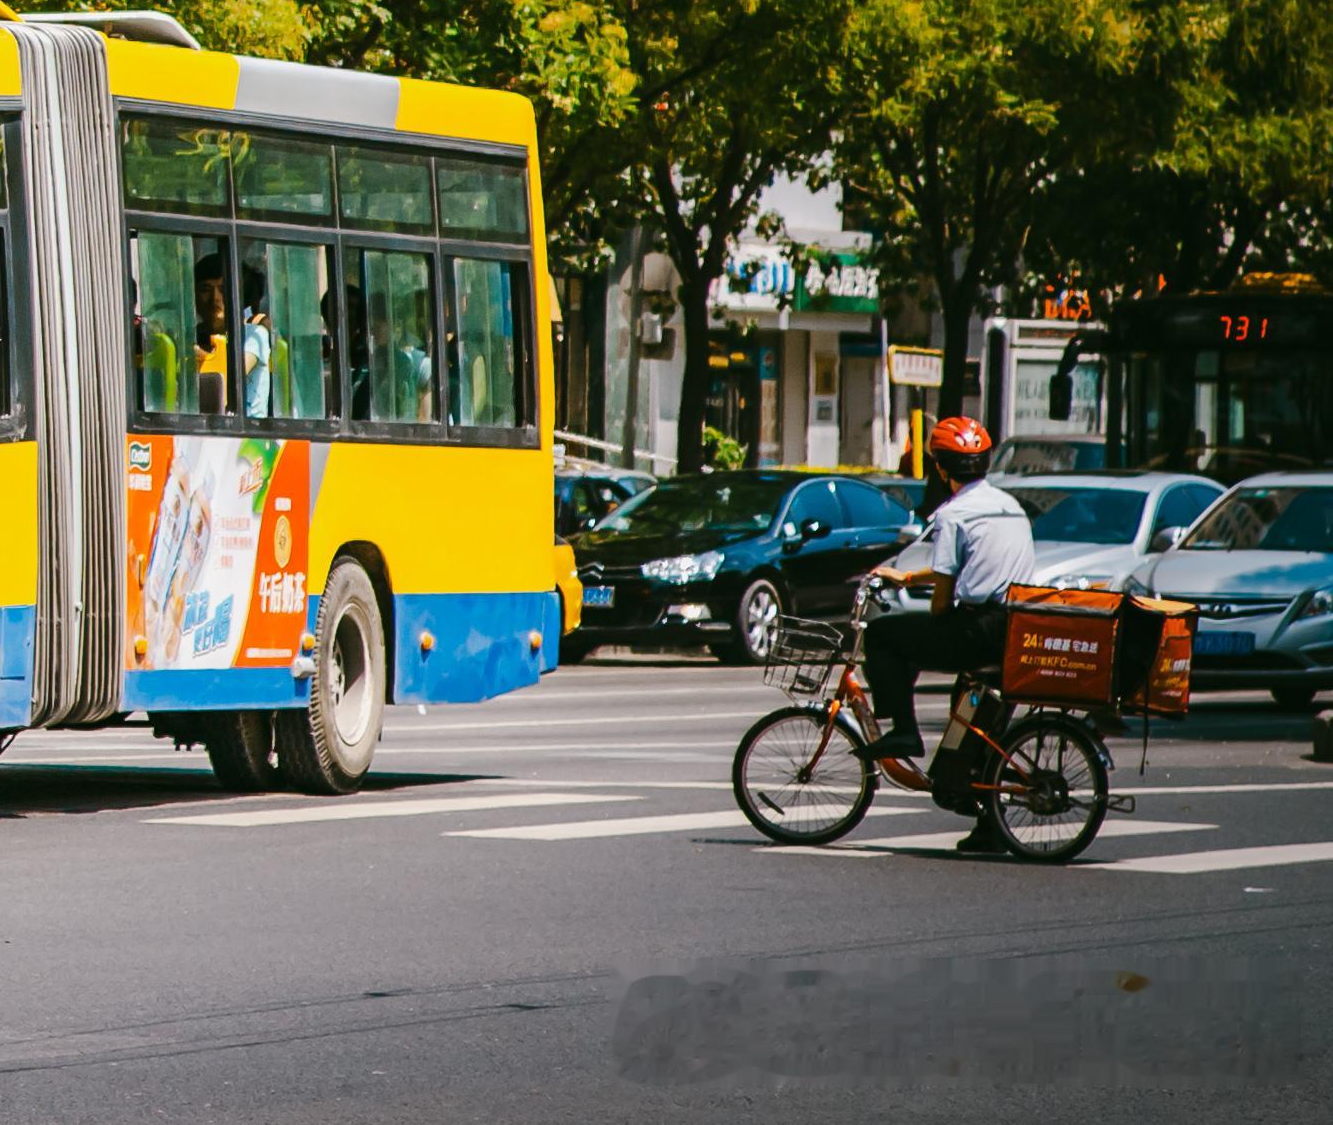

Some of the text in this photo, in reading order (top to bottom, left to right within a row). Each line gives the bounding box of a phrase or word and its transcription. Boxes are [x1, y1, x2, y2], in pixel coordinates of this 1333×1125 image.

[1220, 315, 1268, 341] 731
[258, 571, 306, 614] 午后奶茶
